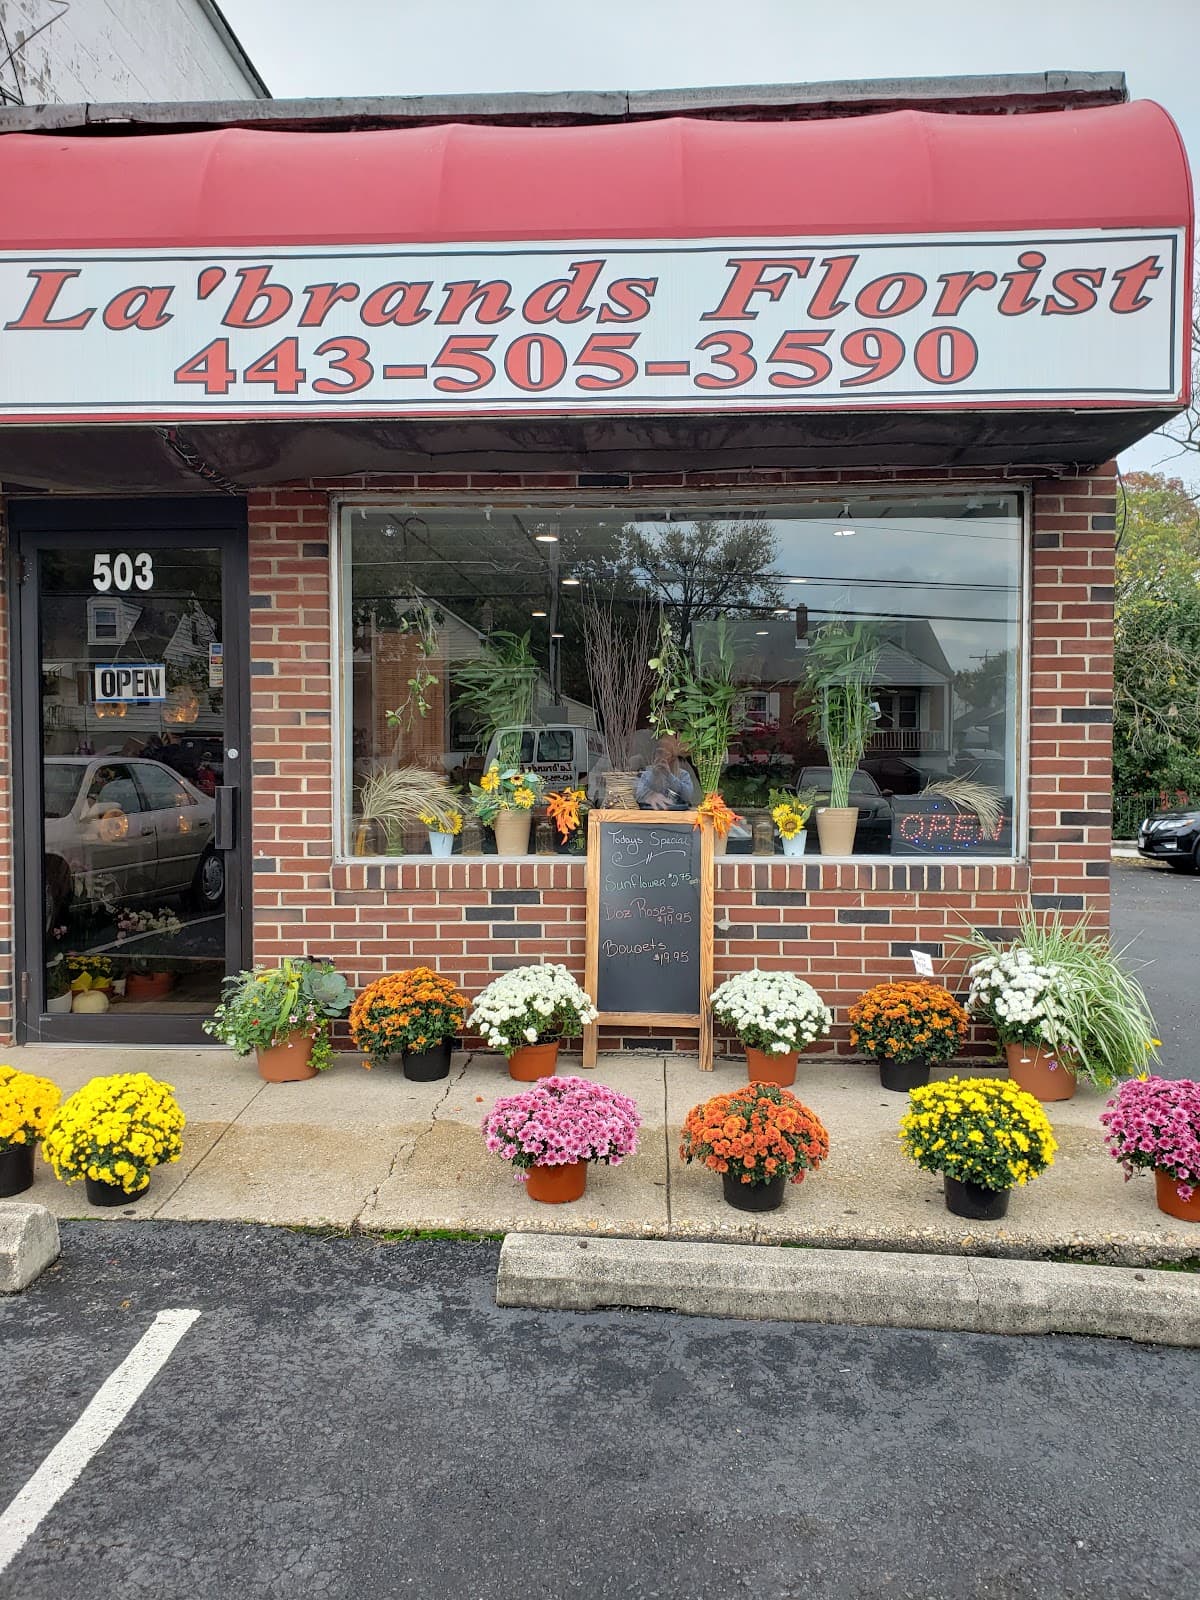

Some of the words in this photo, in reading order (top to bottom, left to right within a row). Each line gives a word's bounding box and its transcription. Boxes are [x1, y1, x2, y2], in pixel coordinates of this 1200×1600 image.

[4, 252, 658, 330] La'brands
[701, 251, 1163, 321] Florist
[174, 326, 978, 395] 443-505-3590
[92, 553, 154, 592] 503
[101, 669, 161, 699] OPEN
[608, 830, 643, 854] Todays
[603, 902, 632, 920] Doz
[630, 897, 674, 917] Roses
[653, 951, 689, 966] $19.95
